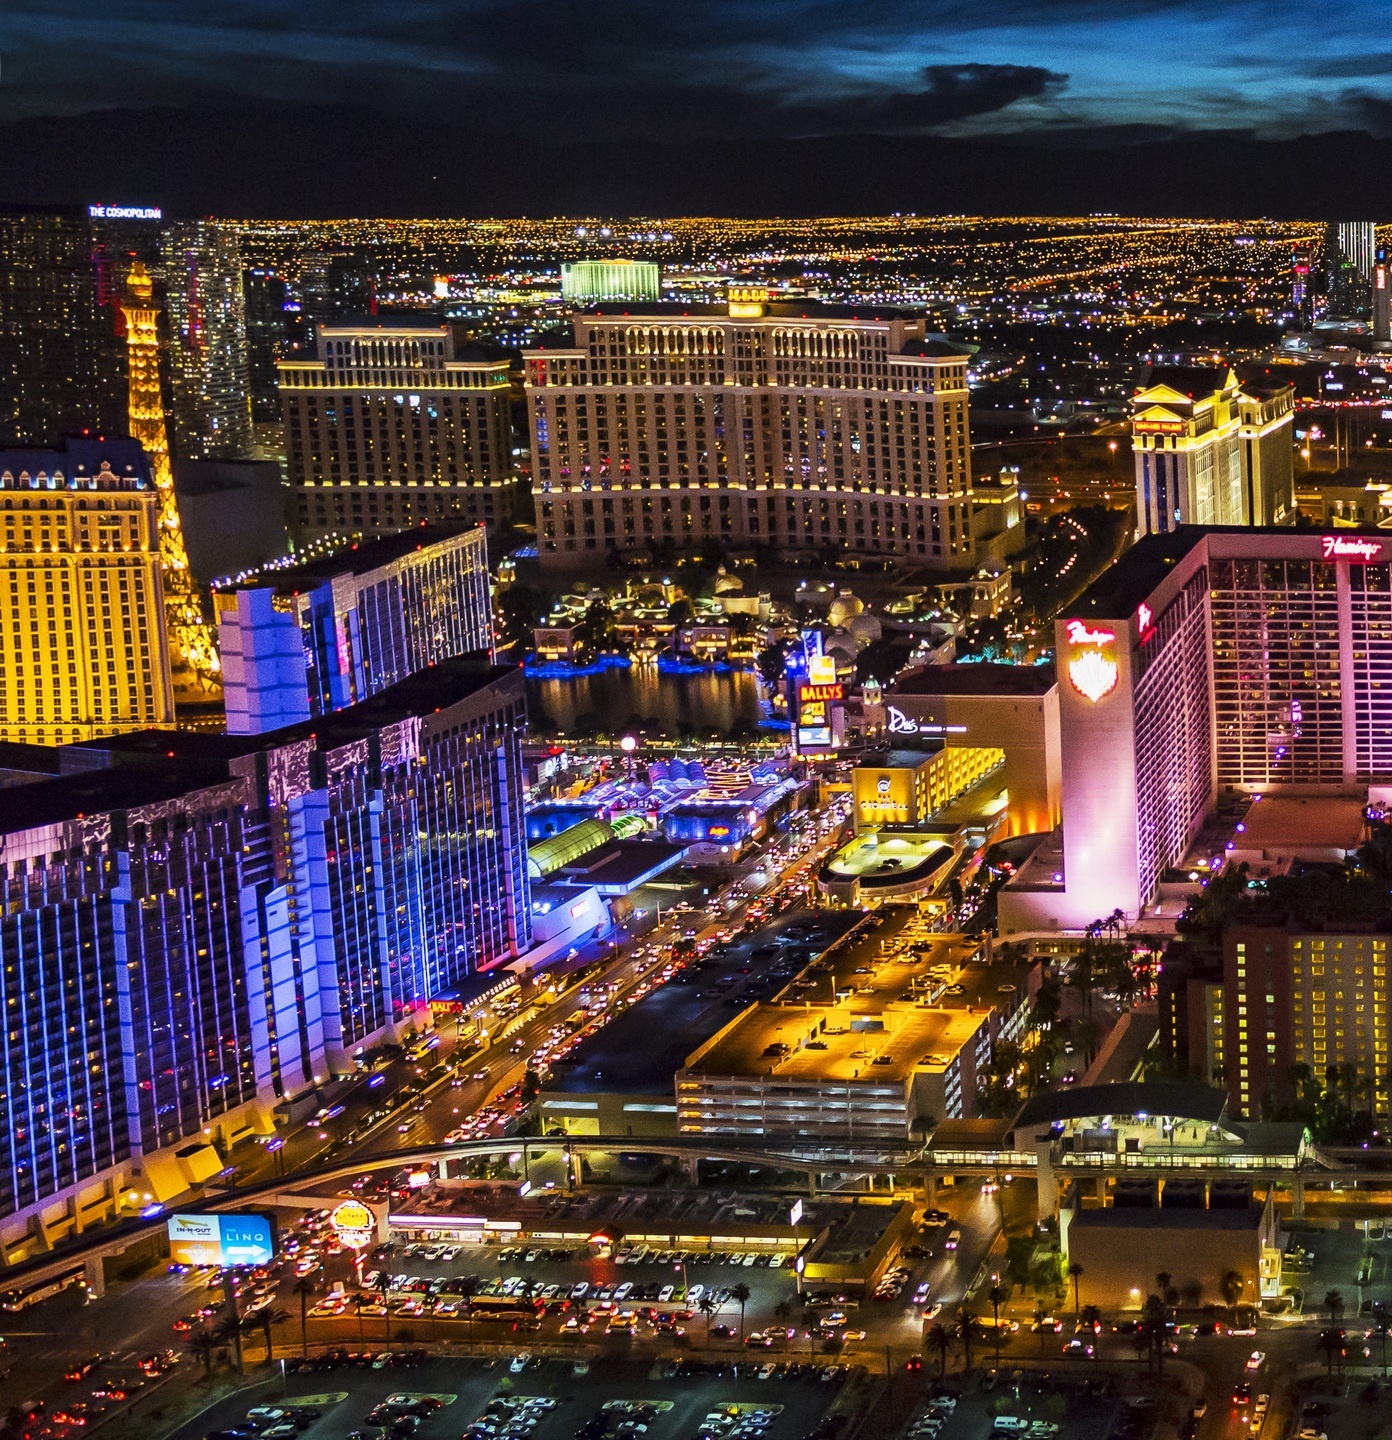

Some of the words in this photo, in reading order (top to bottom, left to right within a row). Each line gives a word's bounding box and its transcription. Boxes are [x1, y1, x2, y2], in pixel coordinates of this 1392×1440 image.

[89, 206, 105, 217] THE
[106, 207, 162, 219] COSMOPOLITAN
[1322, 536, 1381, 560] Flamingo
[226, 1233, 264, 1241] LINQ
